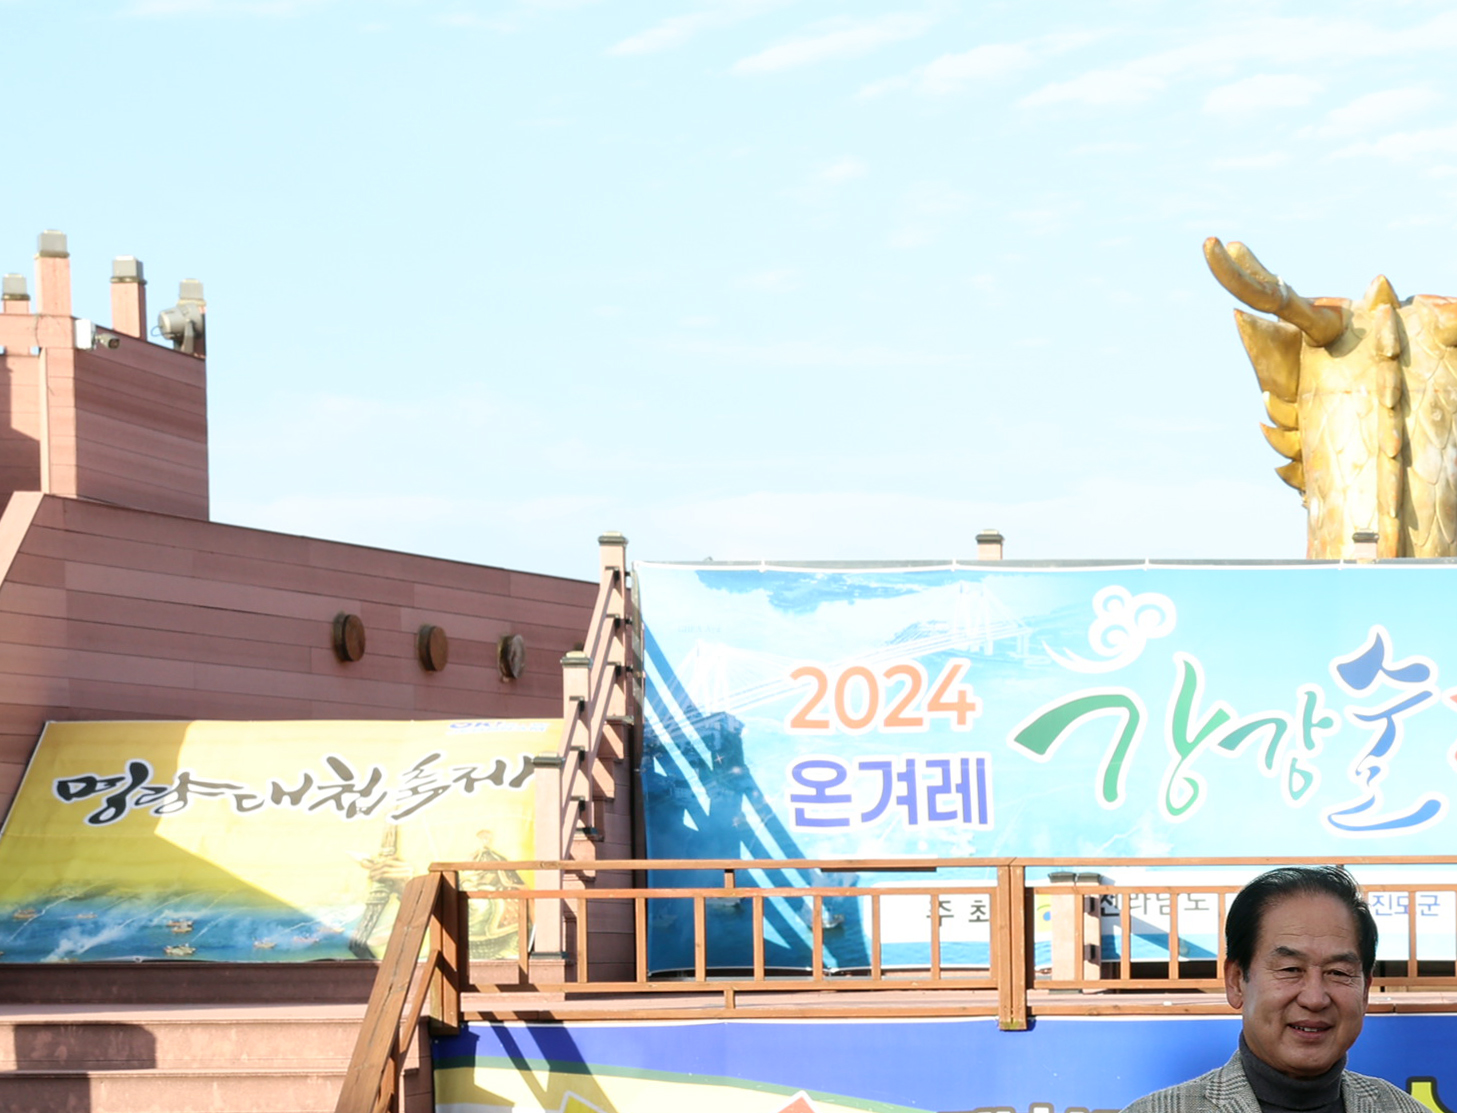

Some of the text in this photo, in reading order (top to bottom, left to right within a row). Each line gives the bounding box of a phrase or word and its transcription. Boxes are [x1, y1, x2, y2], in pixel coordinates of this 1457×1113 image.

[788, 663, 976, 731] 2024
[54, 753, 535, 824] 명량대첩축제
[789, 755, 990, 828] 온겨레
[1371, 894, 1441, 917] 진도군
